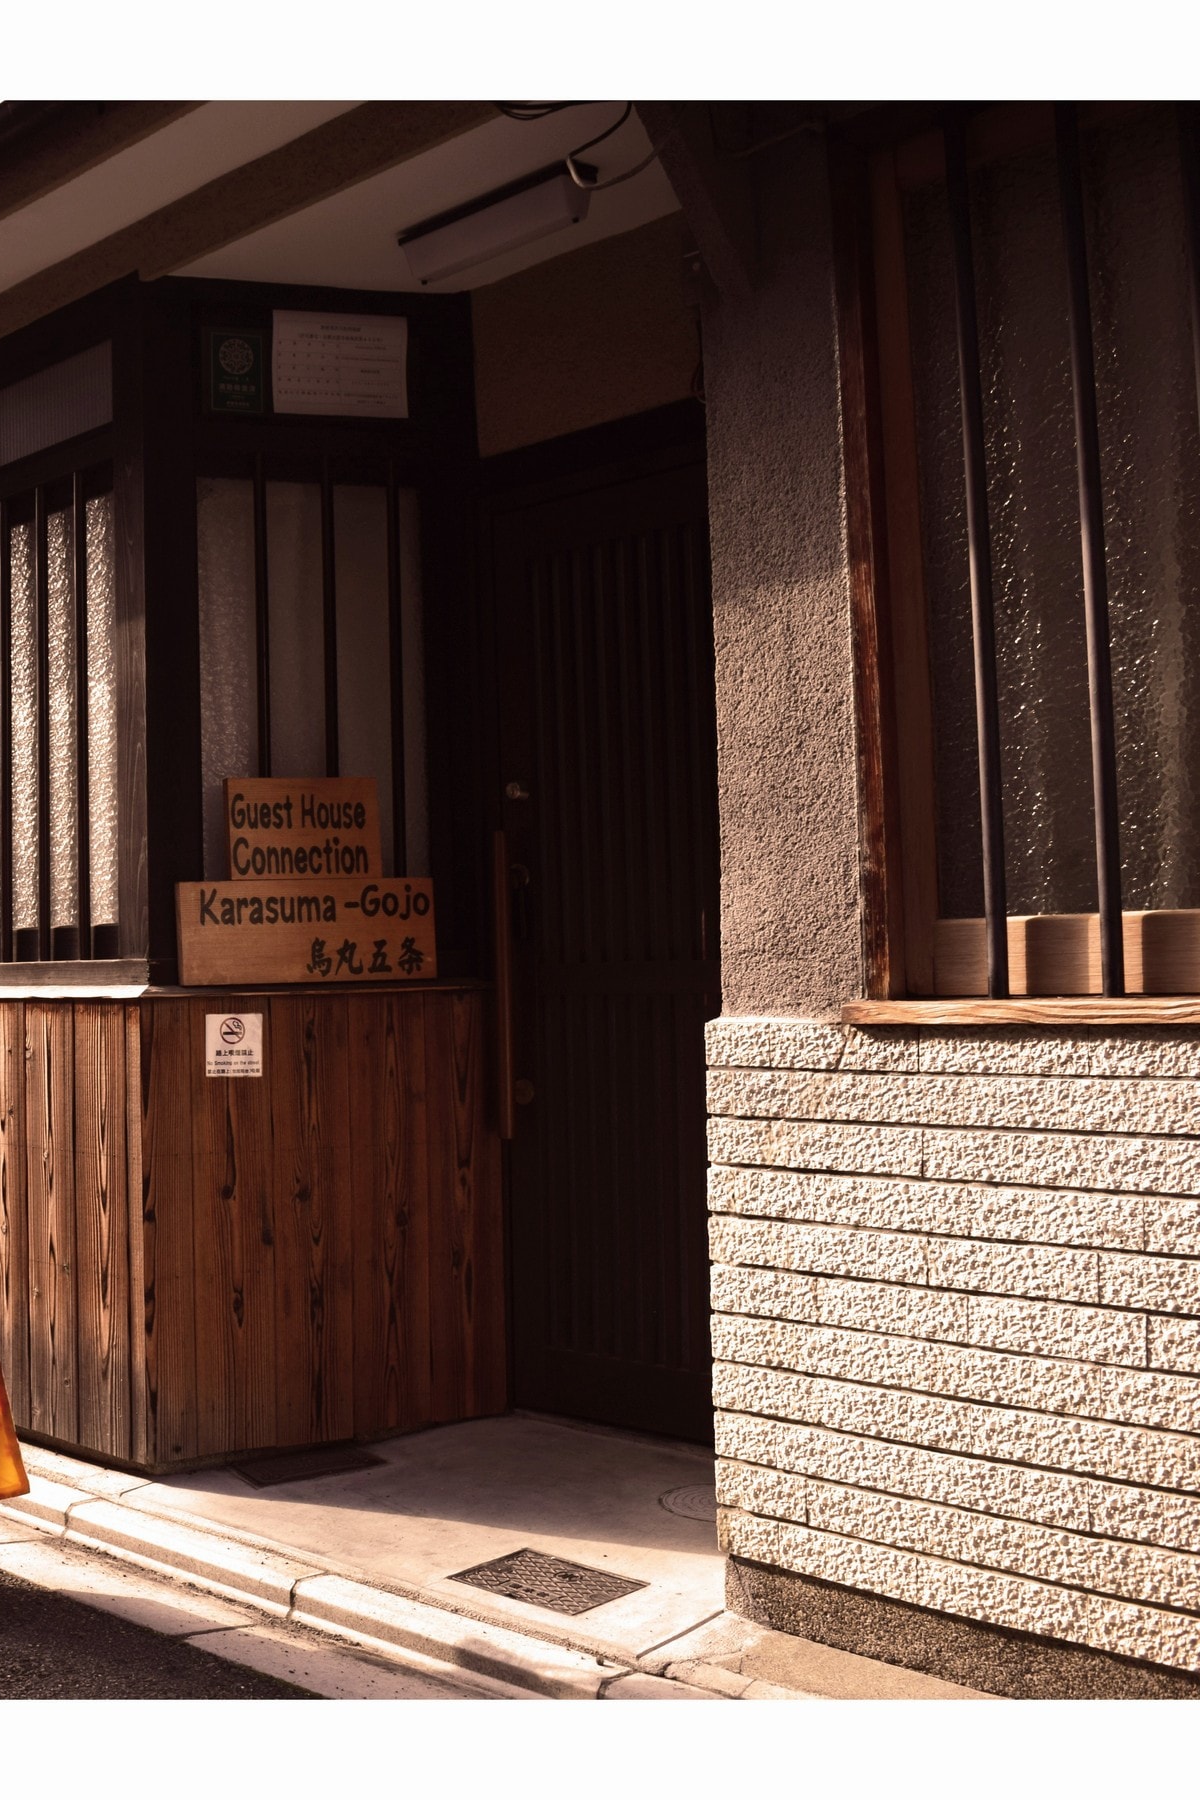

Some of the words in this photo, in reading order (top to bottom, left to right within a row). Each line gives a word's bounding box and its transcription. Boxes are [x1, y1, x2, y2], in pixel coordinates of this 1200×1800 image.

[230, 793, 293, 829] Guest
[301, 794, 366, 829] House
[232, 836, 369, 875] Connection
[200, 888, 336, 926] Karasuma
